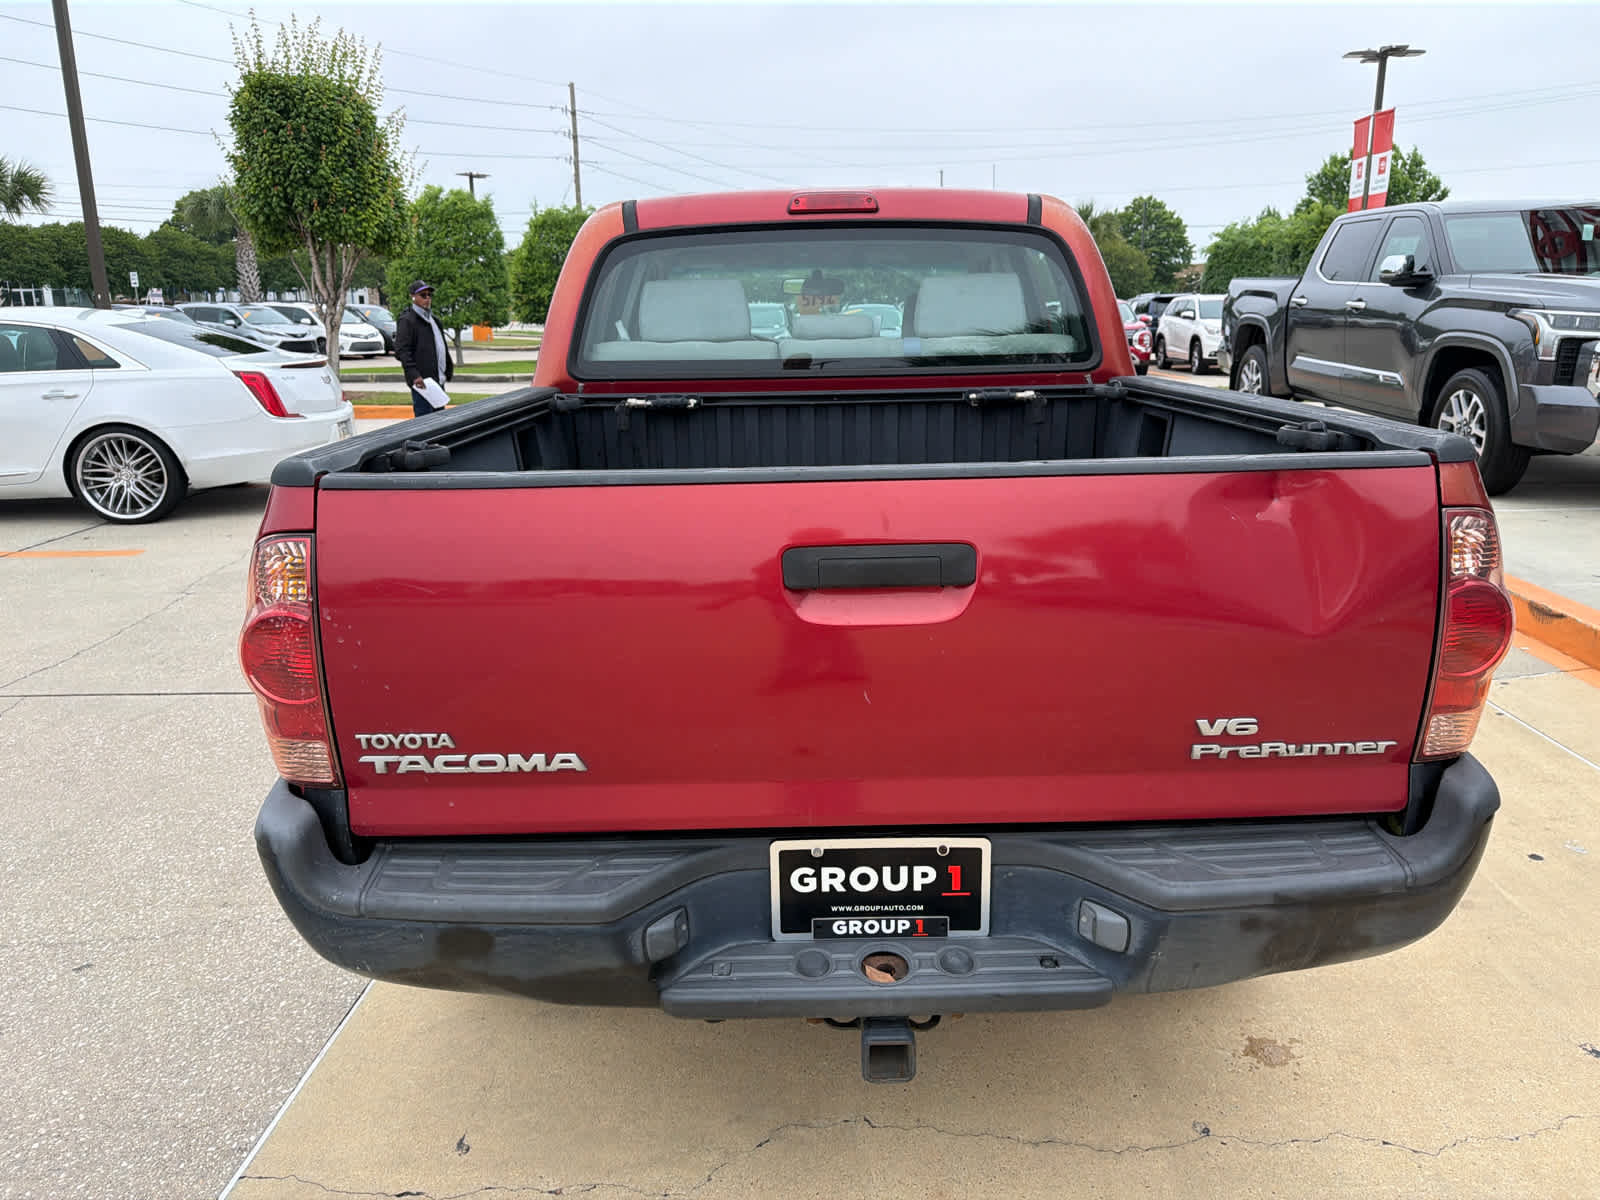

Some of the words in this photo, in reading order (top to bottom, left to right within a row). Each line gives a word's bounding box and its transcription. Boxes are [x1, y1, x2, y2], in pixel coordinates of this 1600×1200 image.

[1196, 718, 1259, 736] V6
[354, 733, 456, 749] TOYOTA
[1191, 741, 1398, 760] PreRunner
[358, 753, 588, 774] TACOMA
[790, 865, 937, 893] GROUP
[832, 919, 910, 935] GROUP
[912, 919, 929, 936] 1
